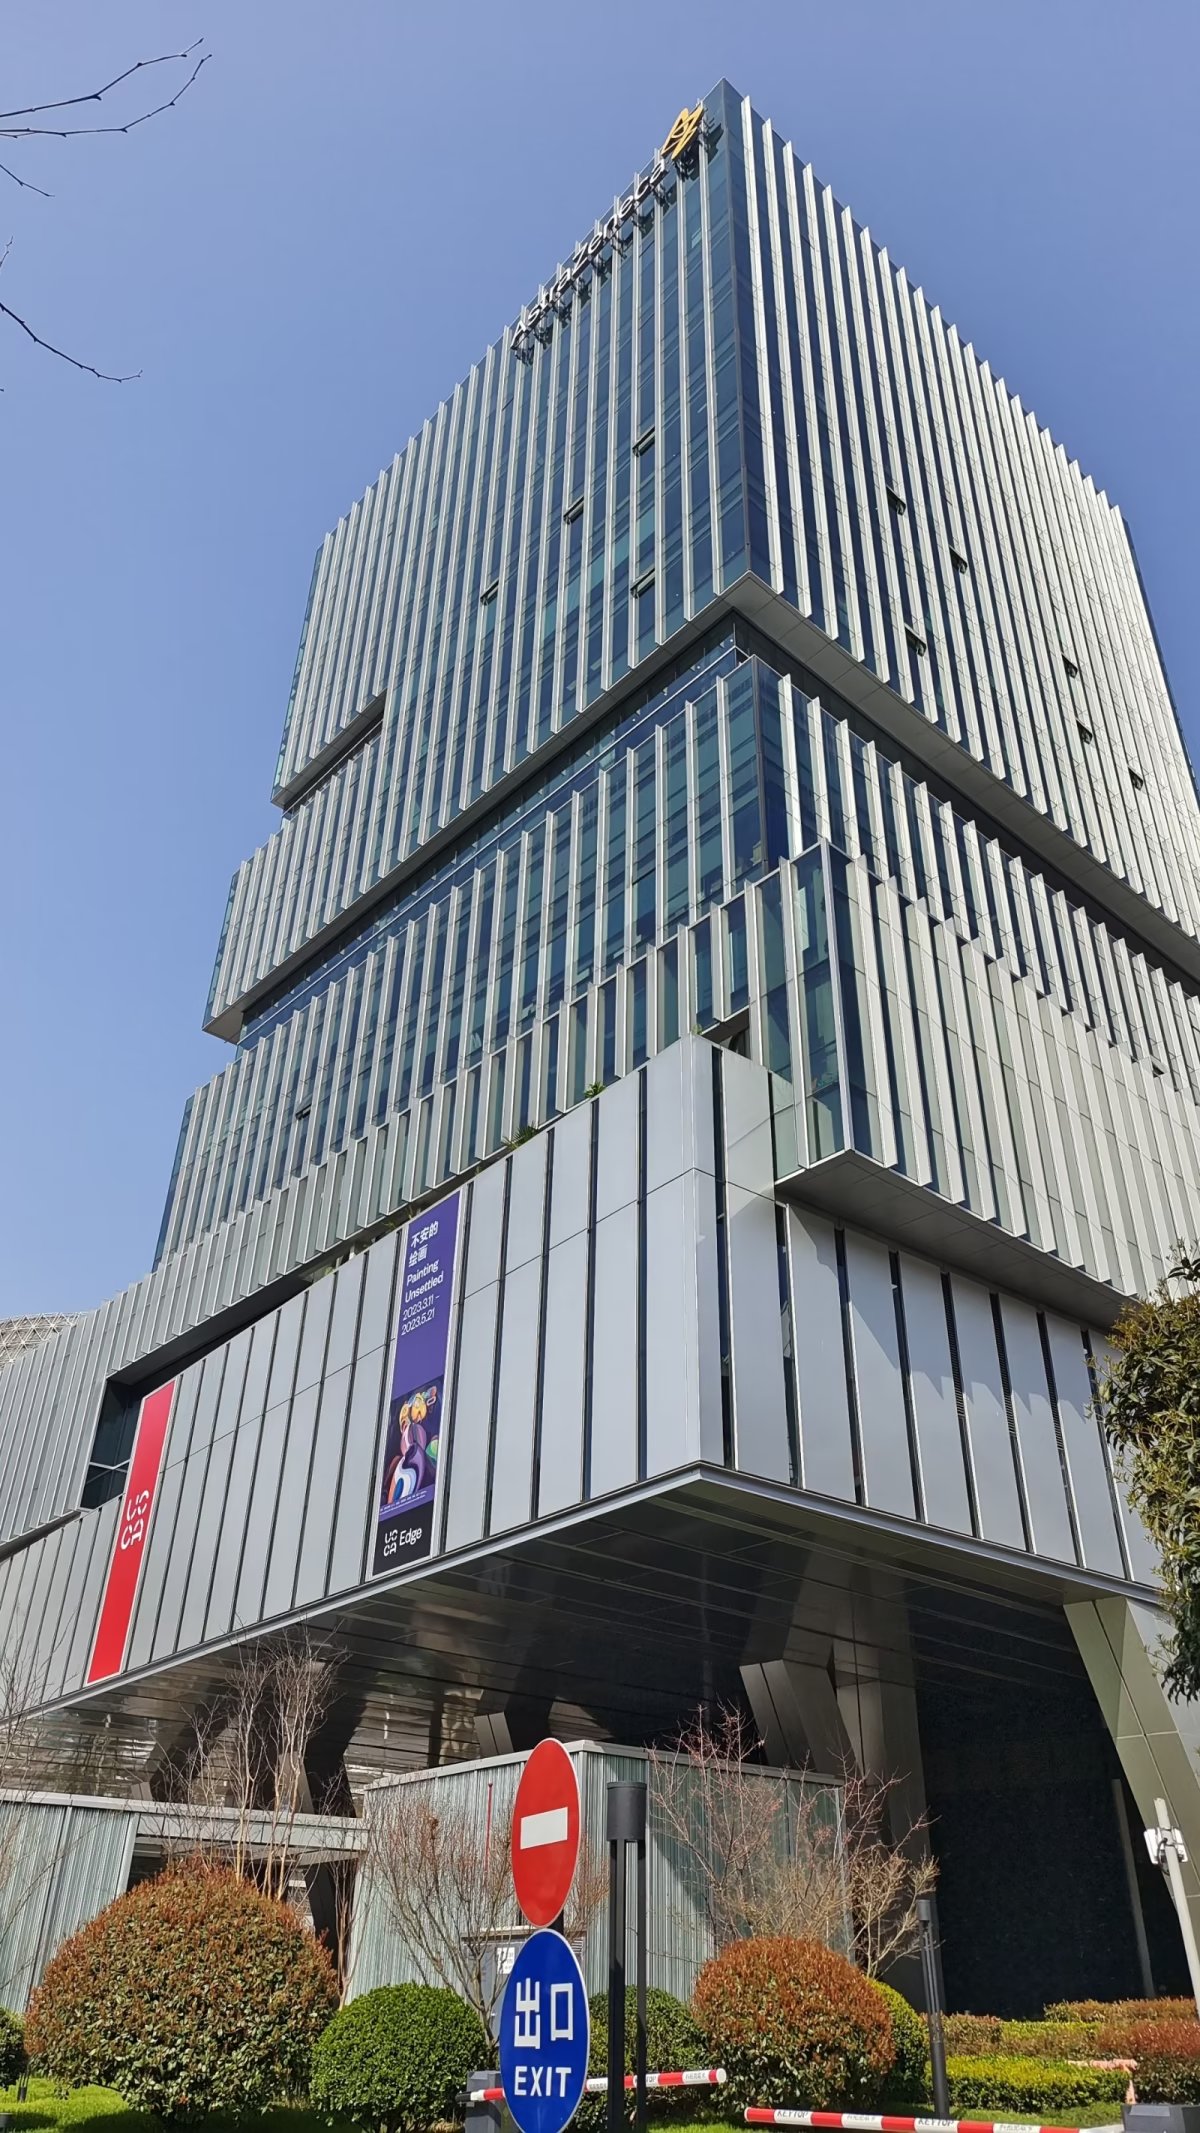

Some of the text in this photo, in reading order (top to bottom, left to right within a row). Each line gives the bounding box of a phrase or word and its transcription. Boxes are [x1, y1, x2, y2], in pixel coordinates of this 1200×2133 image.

[511, 158, 668, 350] AstraZeneca
[410, 1220, 439, 1249] 不安的
[408, 1244, 429, 1267] 绘画
[405, 1270, 444, 1303] Unsettled
[406, 1259, 440, 1287] Painting
[401, 1307, 436, 1336] 2023.5.21
[399, 1526, 423, 1546] Edge
[514, 1977, 574, 2050] 出口
[514, 2065, 572, 2097] EXIT
